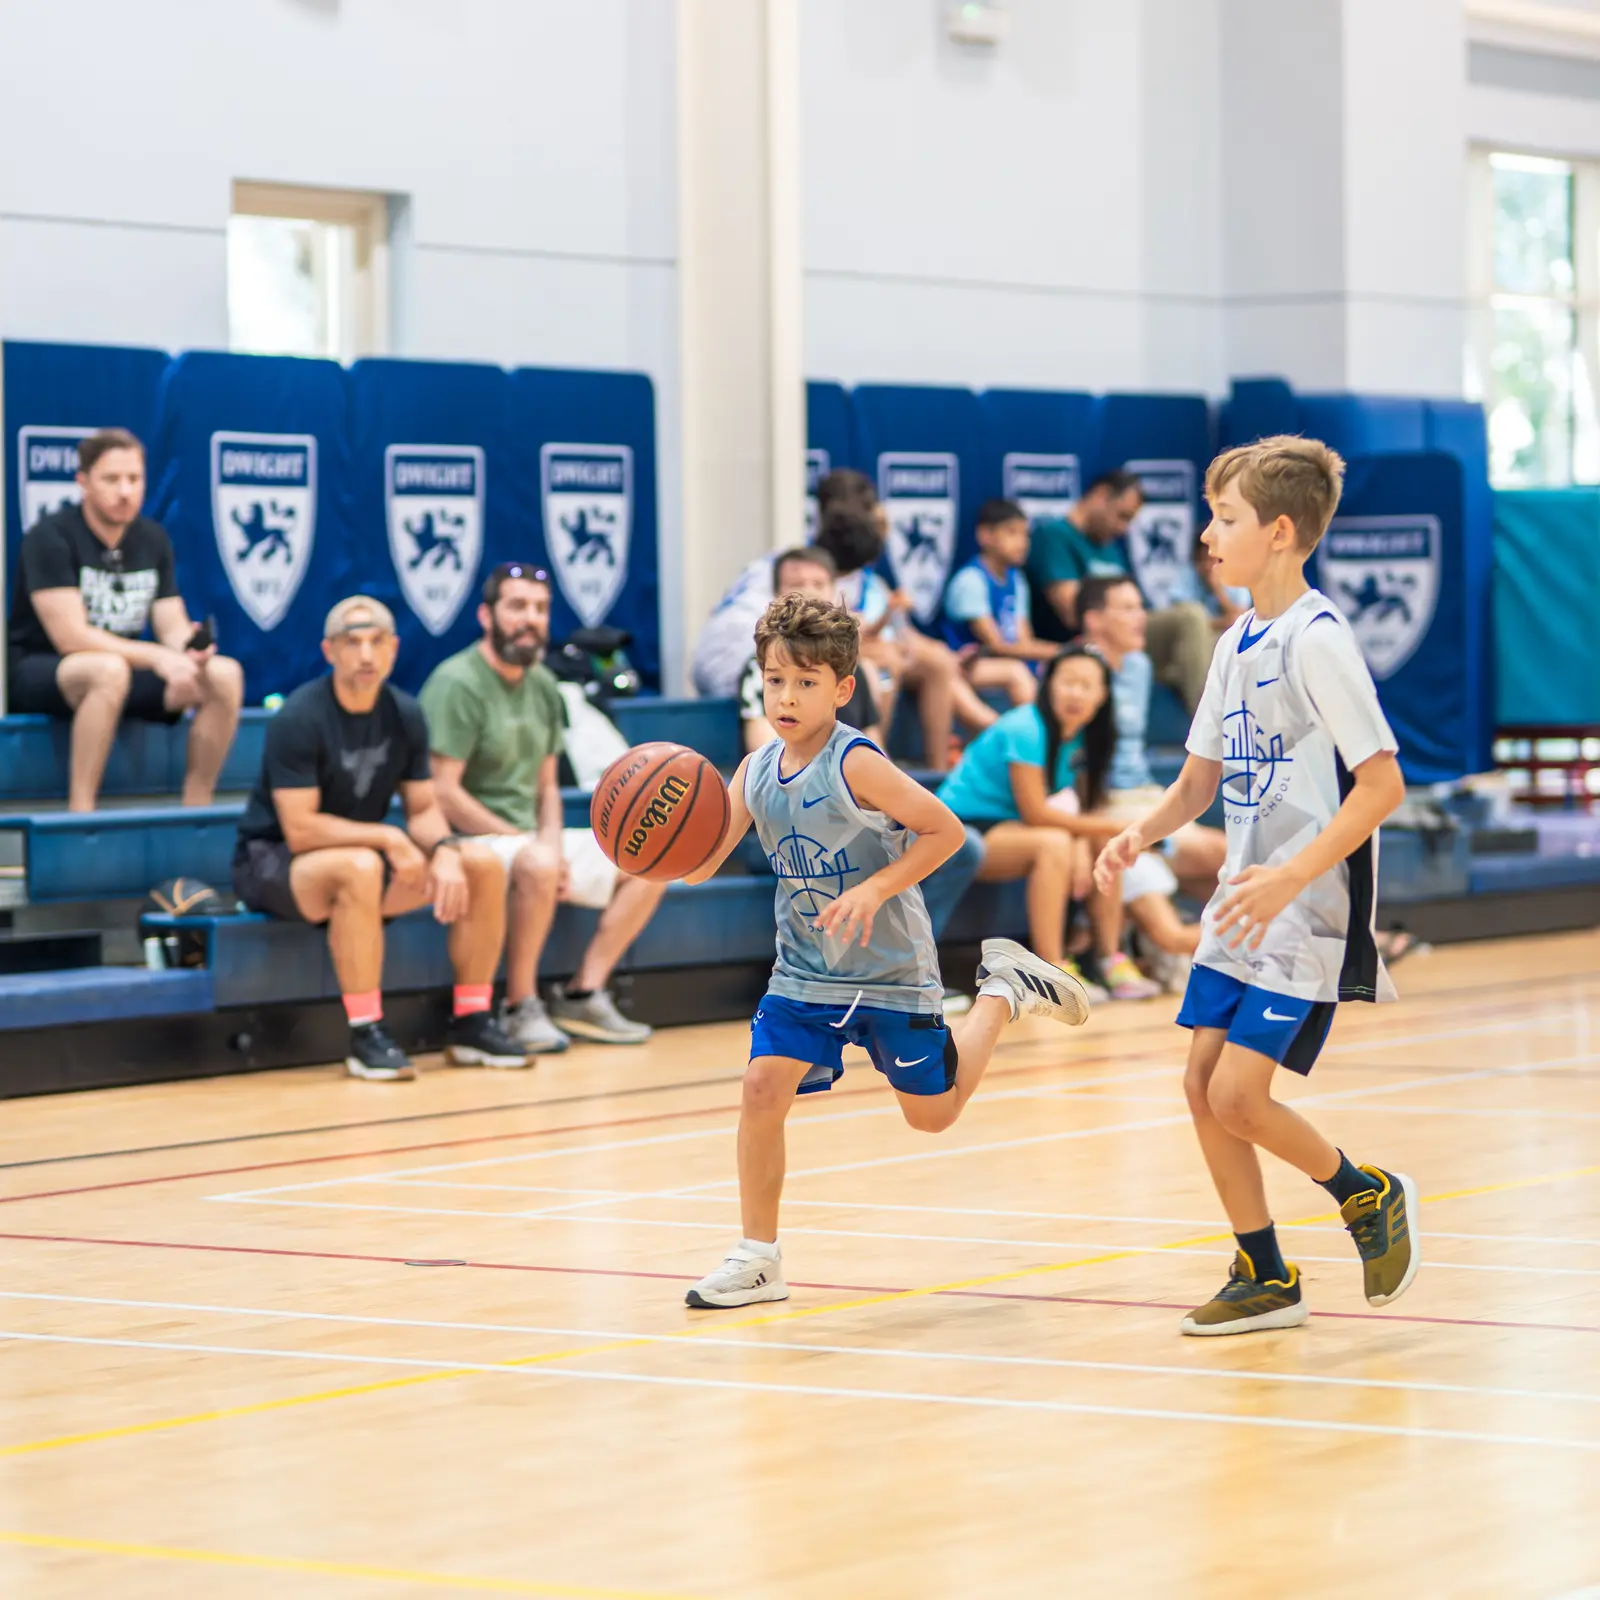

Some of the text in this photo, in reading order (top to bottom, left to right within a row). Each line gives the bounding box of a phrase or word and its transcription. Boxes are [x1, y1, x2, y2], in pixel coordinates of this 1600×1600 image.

[30, 445, 79, 473] DWI
[222, 451, 304, 479] DWIGHT
[1260, 776, 1291, 818] CHOOL
[624, 775, 691, 857] Wilson
